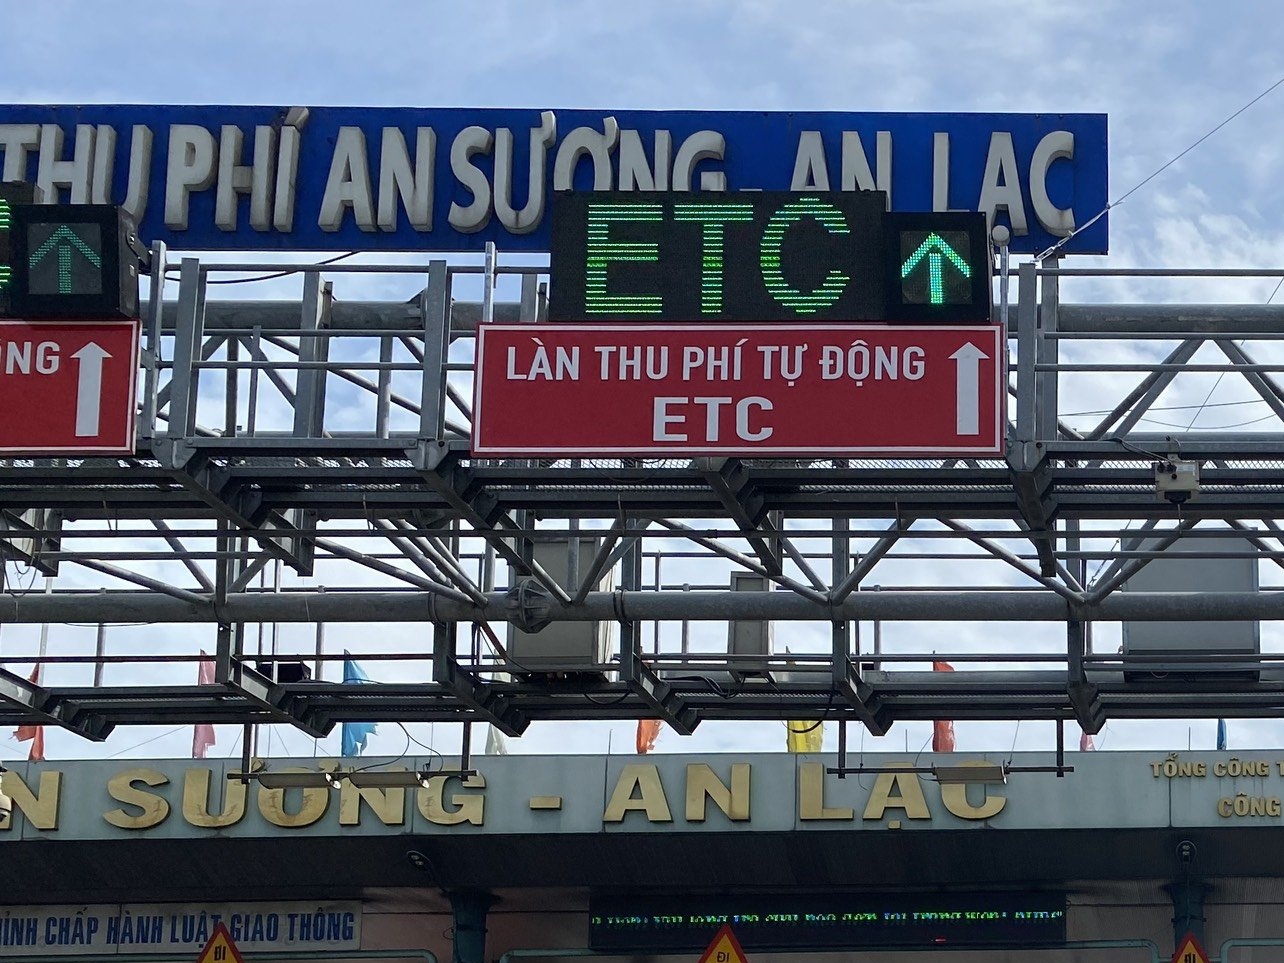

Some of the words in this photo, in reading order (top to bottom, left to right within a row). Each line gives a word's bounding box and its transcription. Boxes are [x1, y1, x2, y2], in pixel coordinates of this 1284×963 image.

[0, 123, 154, 224] THU
[164, 107, 309, 233] PHÍ
[318, 125, 436, 233] AN
[585, 196, 850, 314] ETC
[507, 336, 580, 381] LÀN
[595, 345, 669, 381] THU
[682, 338, 746, 381] PHÍ
[757, 341, 808, 386] TỰ
[819, 340, 925, 387] ĐỘNG
[652, 395, 773, 443] ETC
[1151, 752, 1206, 779] TỔNG
[1213, 757, 1270, 777] CÔNG
[603, 762, 752, 823] AN
[800, 760, 1008, 830] LẠC
[1217, 790, 1282, 818] CÔNG
[45, 907, 99, 945] CHẤP
[107, 909, 163, 944] HÀNH
[230, 912, 279, 942] GIAO
[288, 907, 355, 942] THÔNG
[213, 946, 228, 962] ĐI
[717, 952, 730, 963] ĐI
